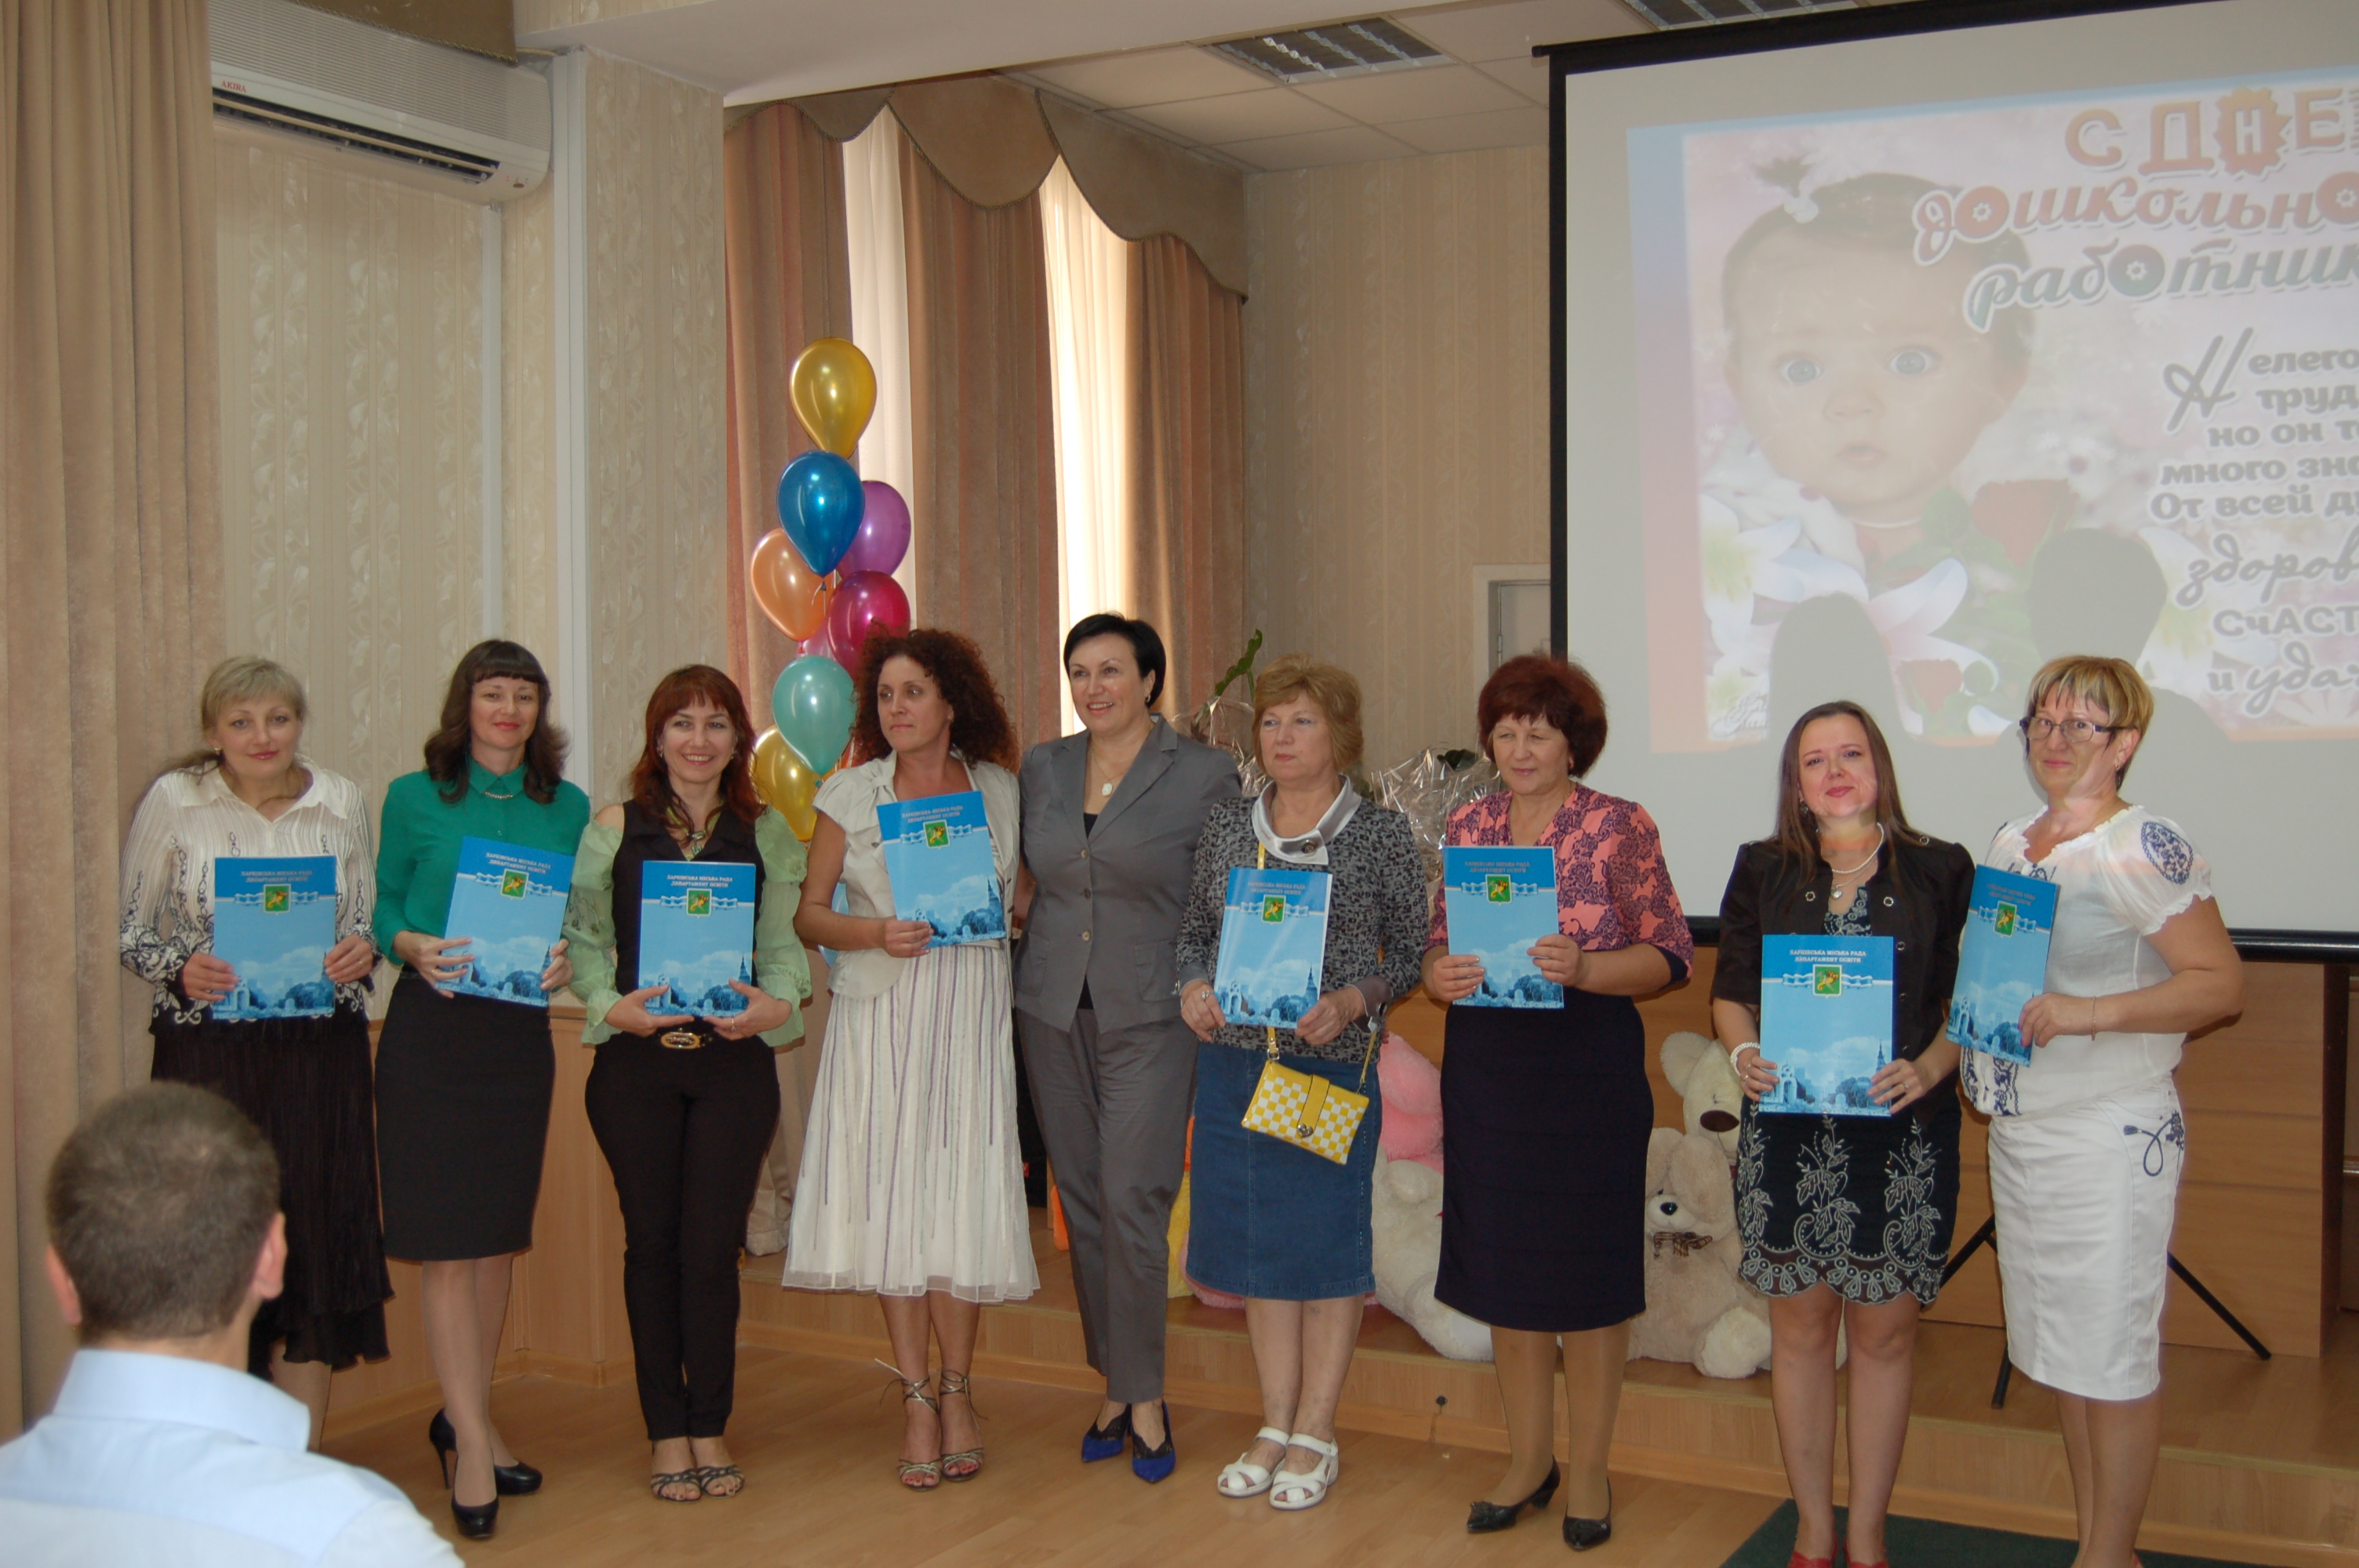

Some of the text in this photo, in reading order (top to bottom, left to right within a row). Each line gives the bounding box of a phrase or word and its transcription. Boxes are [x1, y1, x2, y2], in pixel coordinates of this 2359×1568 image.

[222, 80, 247, 93] AKIRA
[2138, 85, 2359, 177] ДНЕ
[2208, 425, 2260, 448] но
[2270, 423, 2324, 445] он
[2160, 459, 2287, 486] много
[2150, 492, 2205, 521] От
[2215, 484, 2314, 518] всей
